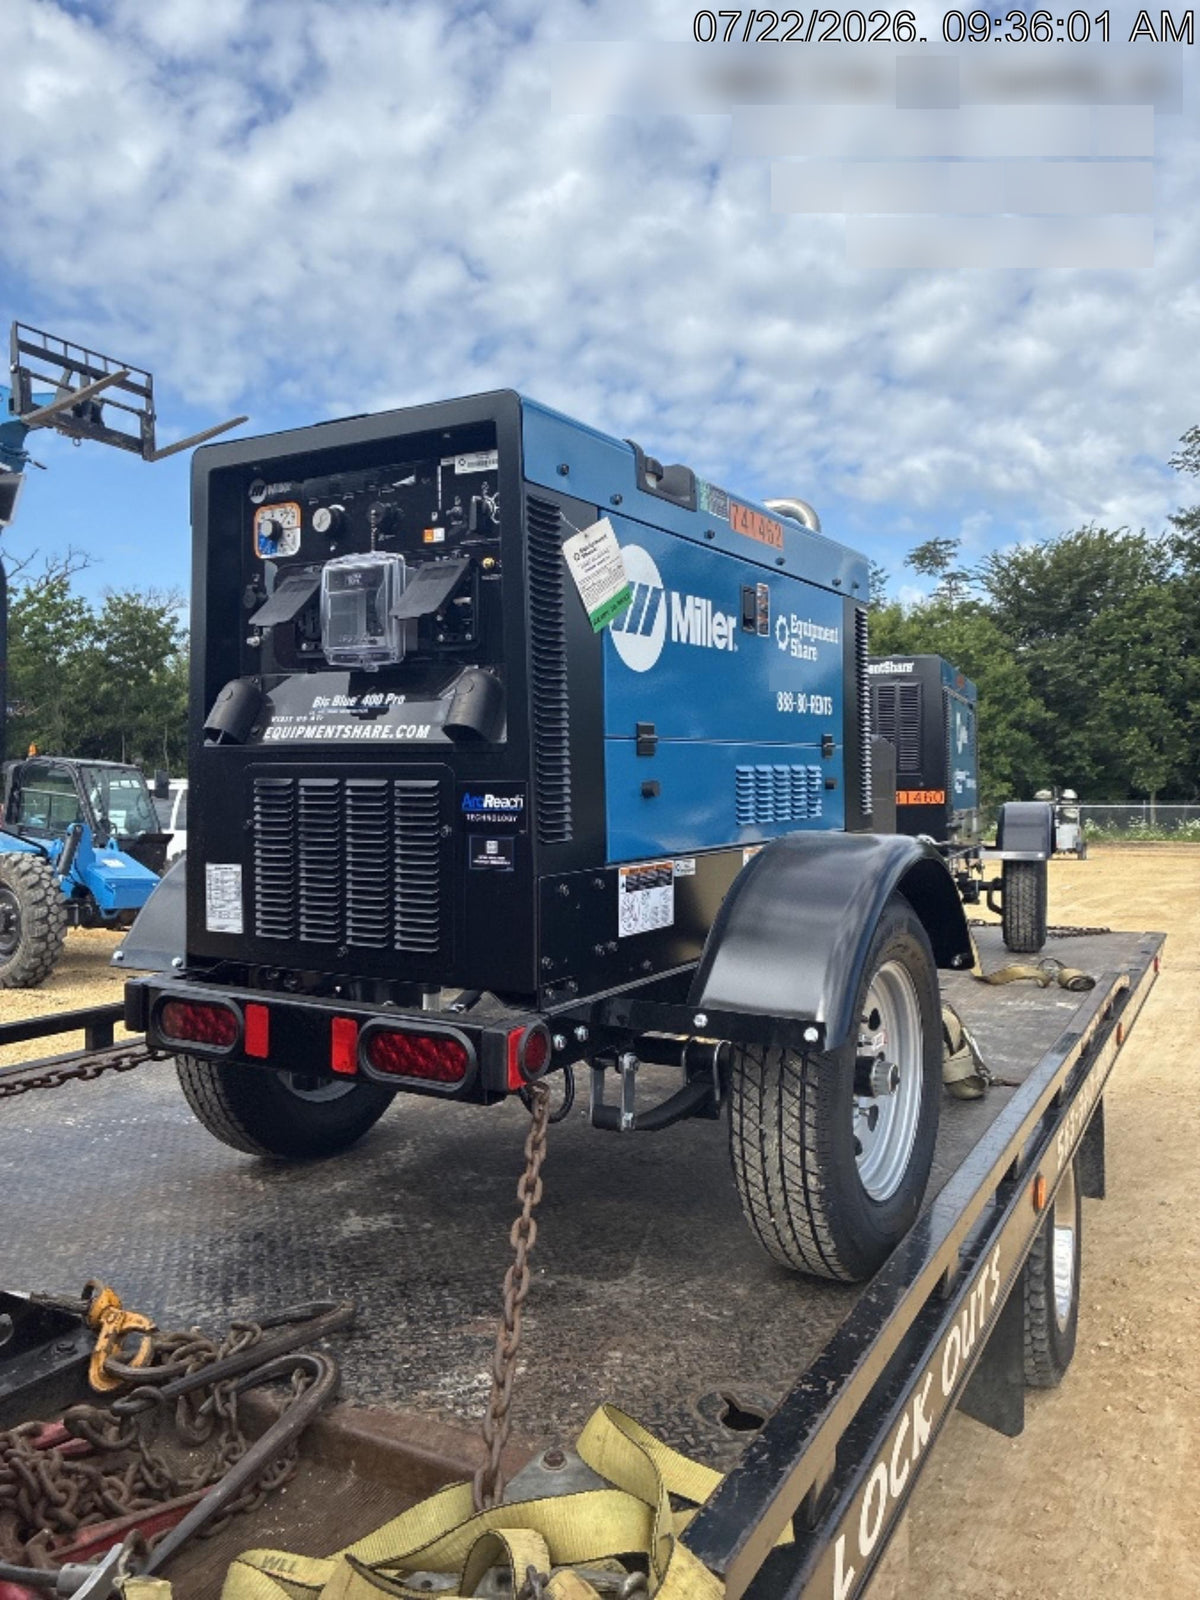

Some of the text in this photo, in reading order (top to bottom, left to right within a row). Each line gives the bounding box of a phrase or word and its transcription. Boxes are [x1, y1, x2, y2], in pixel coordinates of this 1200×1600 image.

[671, 591, 737, 652] Miller
[790, 613, 839, 644] Equipment
[790, 638, 818, 661] Share
[331, 694, 358, 707] Blue
[361, 693, 384, 706] 400
[385, 692, 406, 705] Pro
[262, 724, 432, 741] EQUIPMENTSHARE.COM
[462, 793, 525, 810] ArcReach
[832, 1243, 1001, 1600] LOCK OUTS
